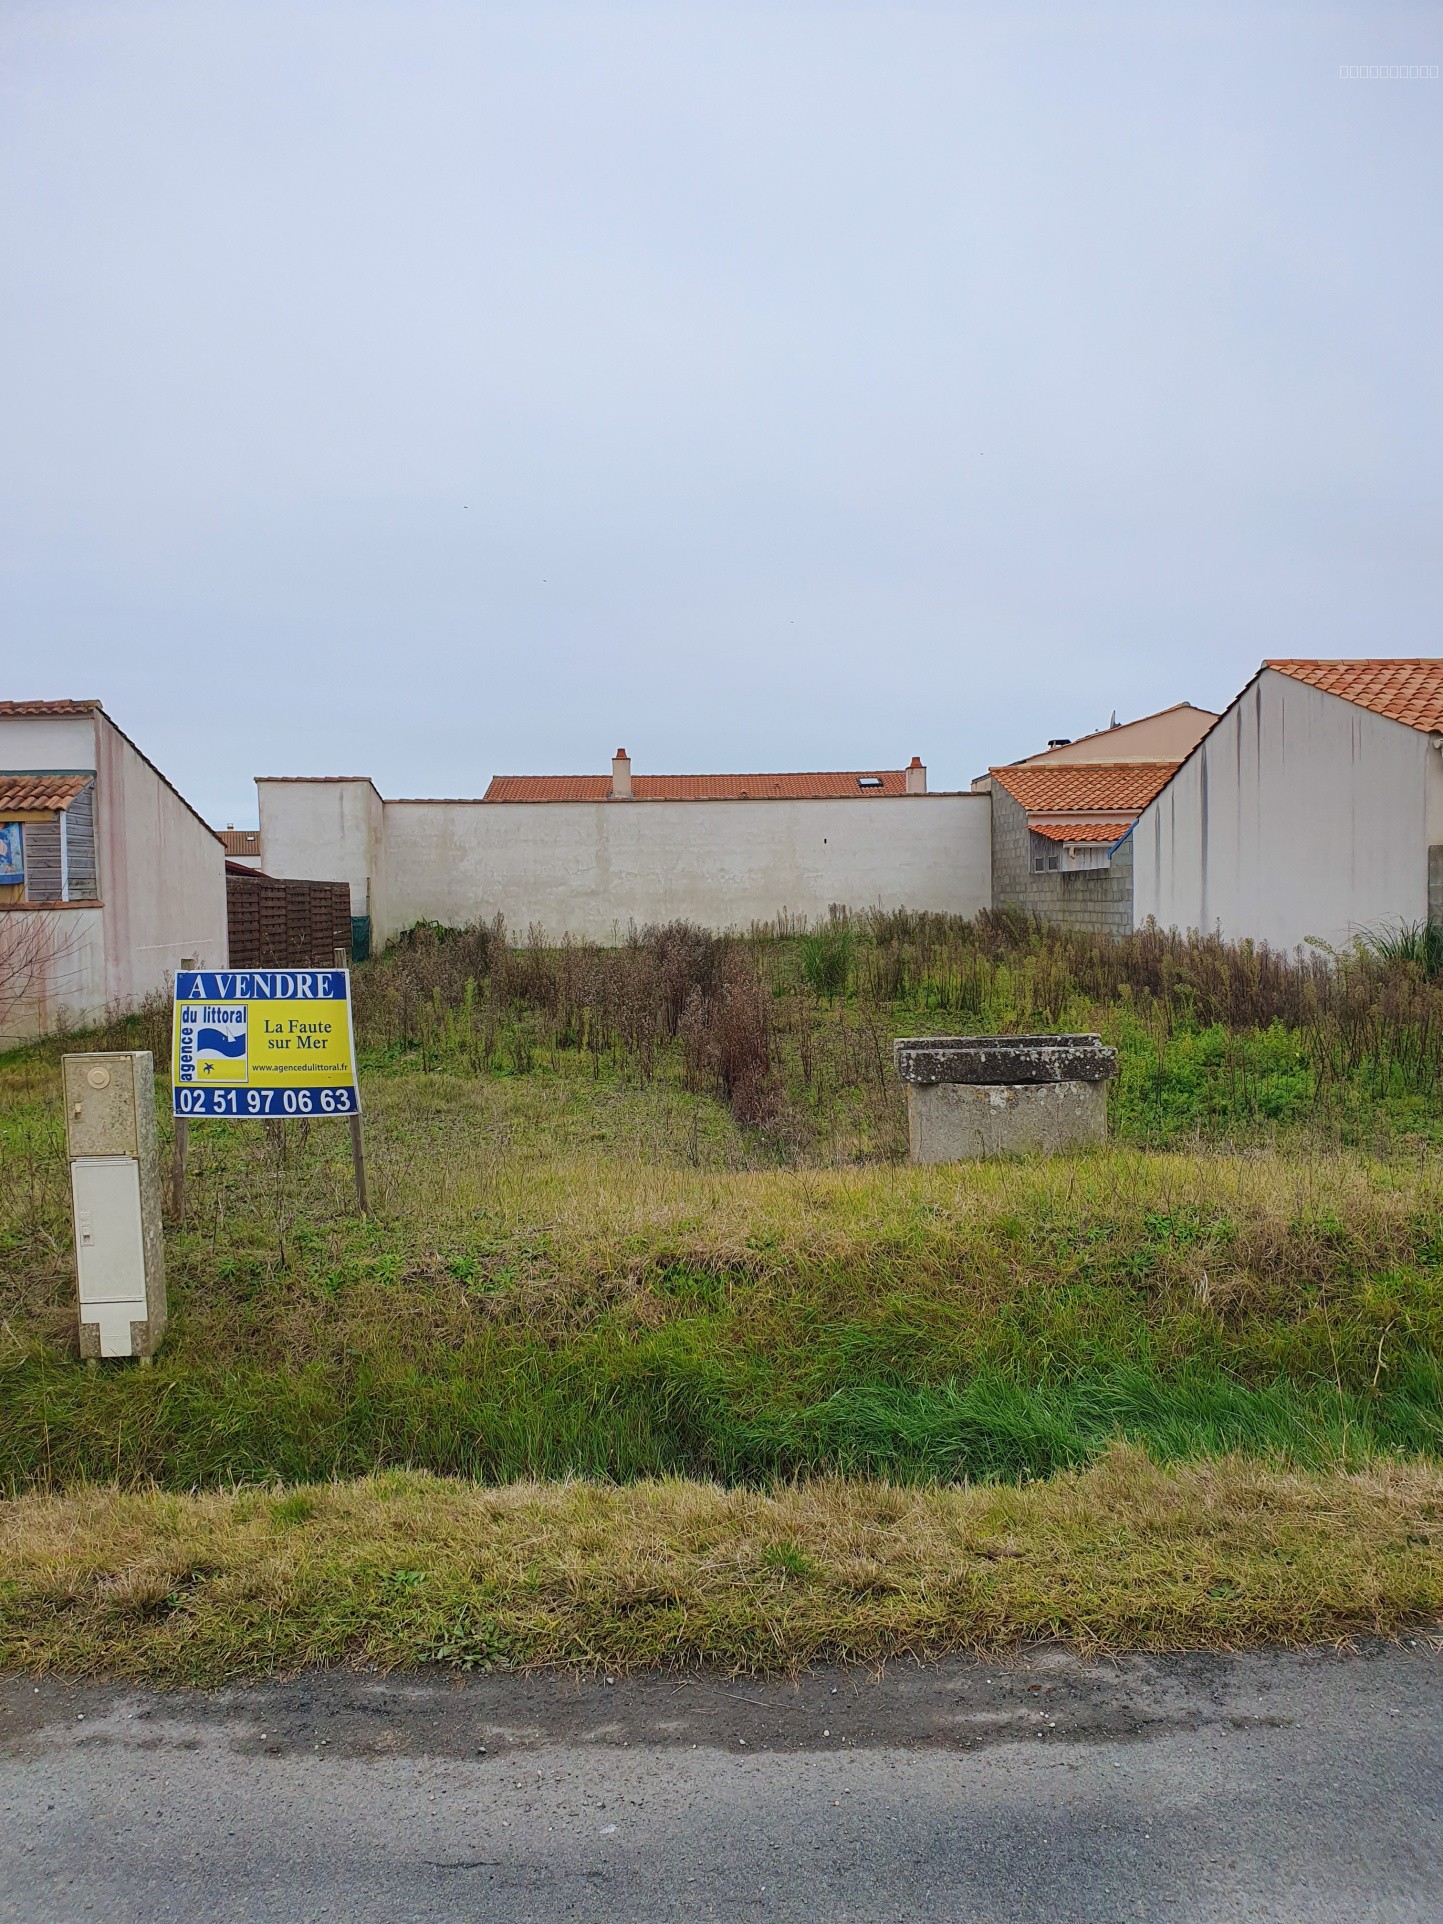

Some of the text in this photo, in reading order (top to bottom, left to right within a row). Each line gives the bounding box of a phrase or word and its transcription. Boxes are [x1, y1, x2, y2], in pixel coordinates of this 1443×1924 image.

[188, 974, 333, 998] A VENDRE
[182, 1006, 246, 1023] du littoral
[264, 1020, 332, 1033] La Faute
[268, 1036, 328, 1049] sur Mer
[181, 1027, 195, 1081] agence
[252, 1064, 347, 1073] www.agencedulittoral.fr
[180, 1090, 350, 1112] 02 51 97 06 63
